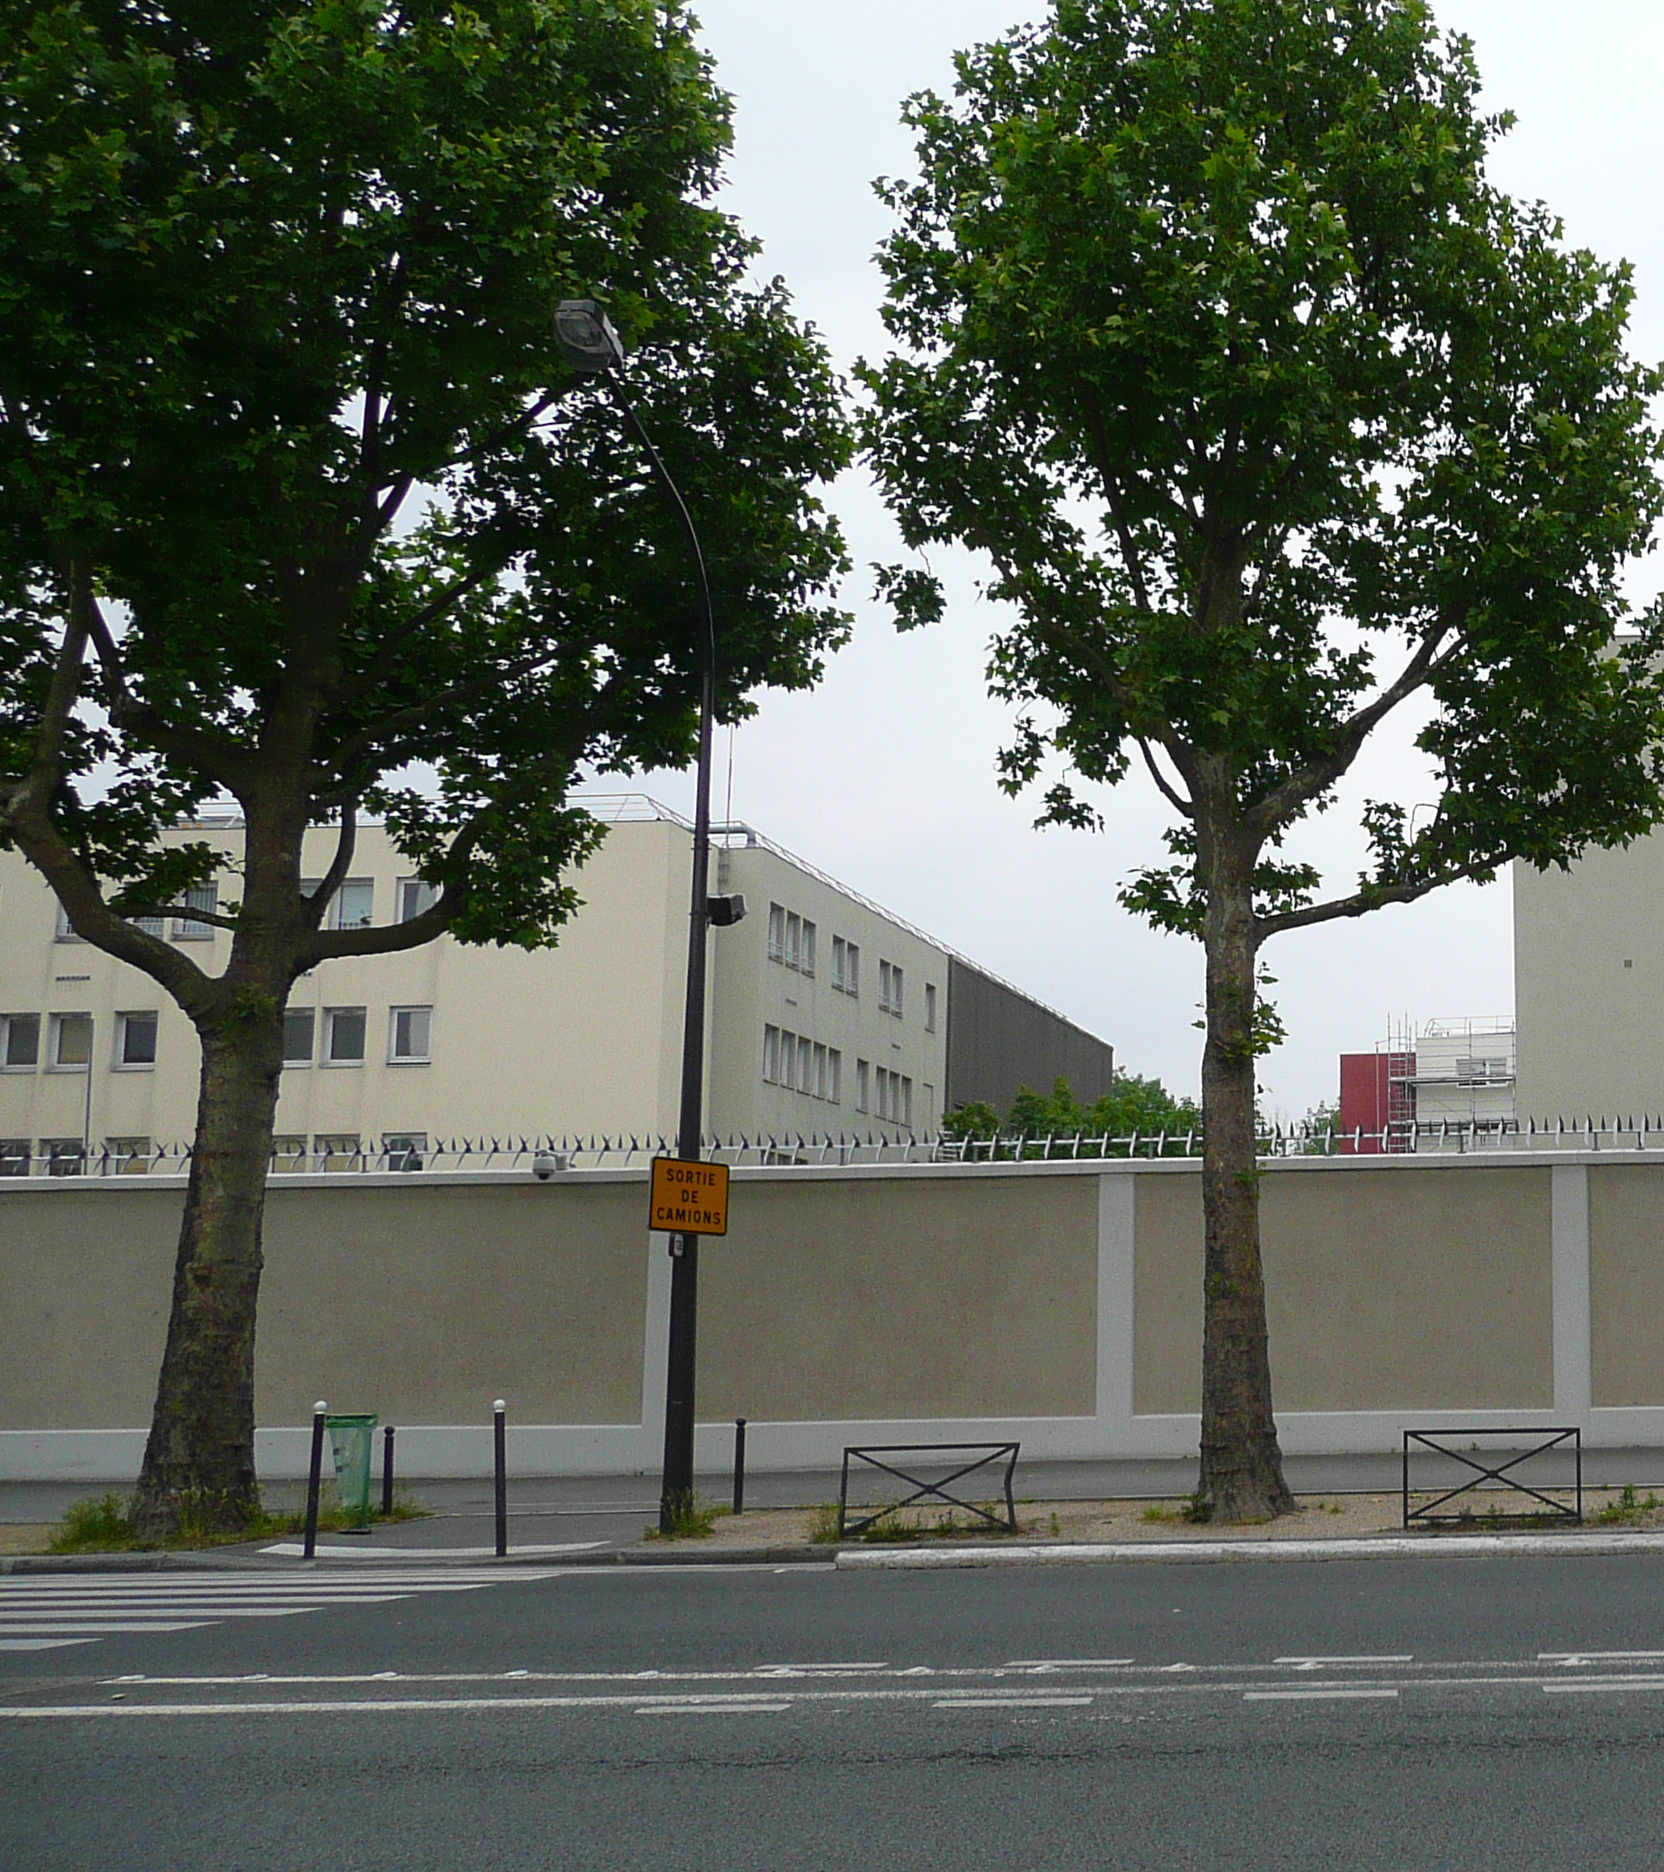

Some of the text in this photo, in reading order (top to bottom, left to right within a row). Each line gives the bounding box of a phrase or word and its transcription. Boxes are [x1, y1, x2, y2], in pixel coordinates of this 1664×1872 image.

[667, 1168, 716, 1186] SORTIE
[681, 1189, 699, 1204] DE
[657, 1207, 721, 1225] CAMIONS
